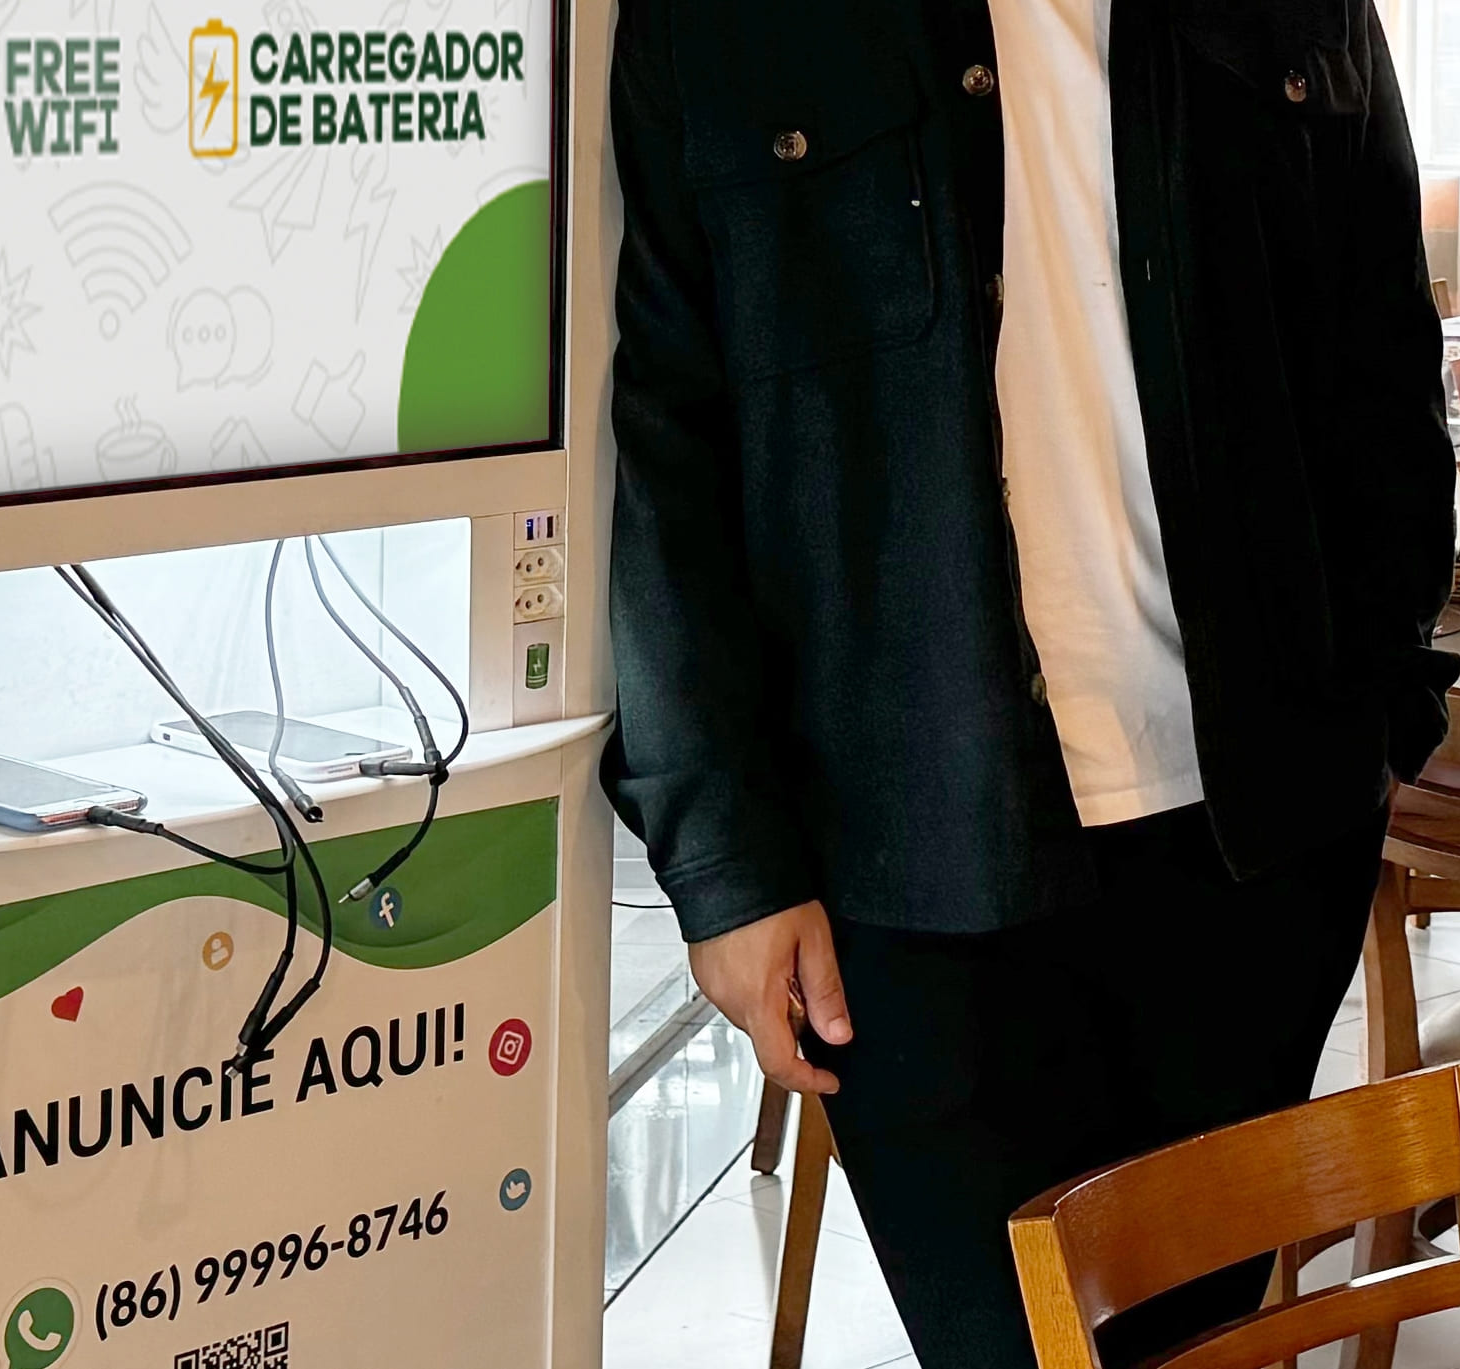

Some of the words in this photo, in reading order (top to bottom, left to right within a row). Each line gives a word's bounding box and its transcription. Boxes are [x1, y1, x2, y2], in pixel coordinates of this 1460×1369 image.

[4, 39, 121, 96] FREE
[249, 32, 525, 85] CARREGADOR
[5, 100, 119, 156] WIFI
[249, 94, 302, 146] DE
[312, 90, 487, 145] BATERIA
[296, 1002, 466, 1104] AQUI!
[94, 1265, 181, 1341] (86)
[194, 1190, 450, 1305] 99996-8746
